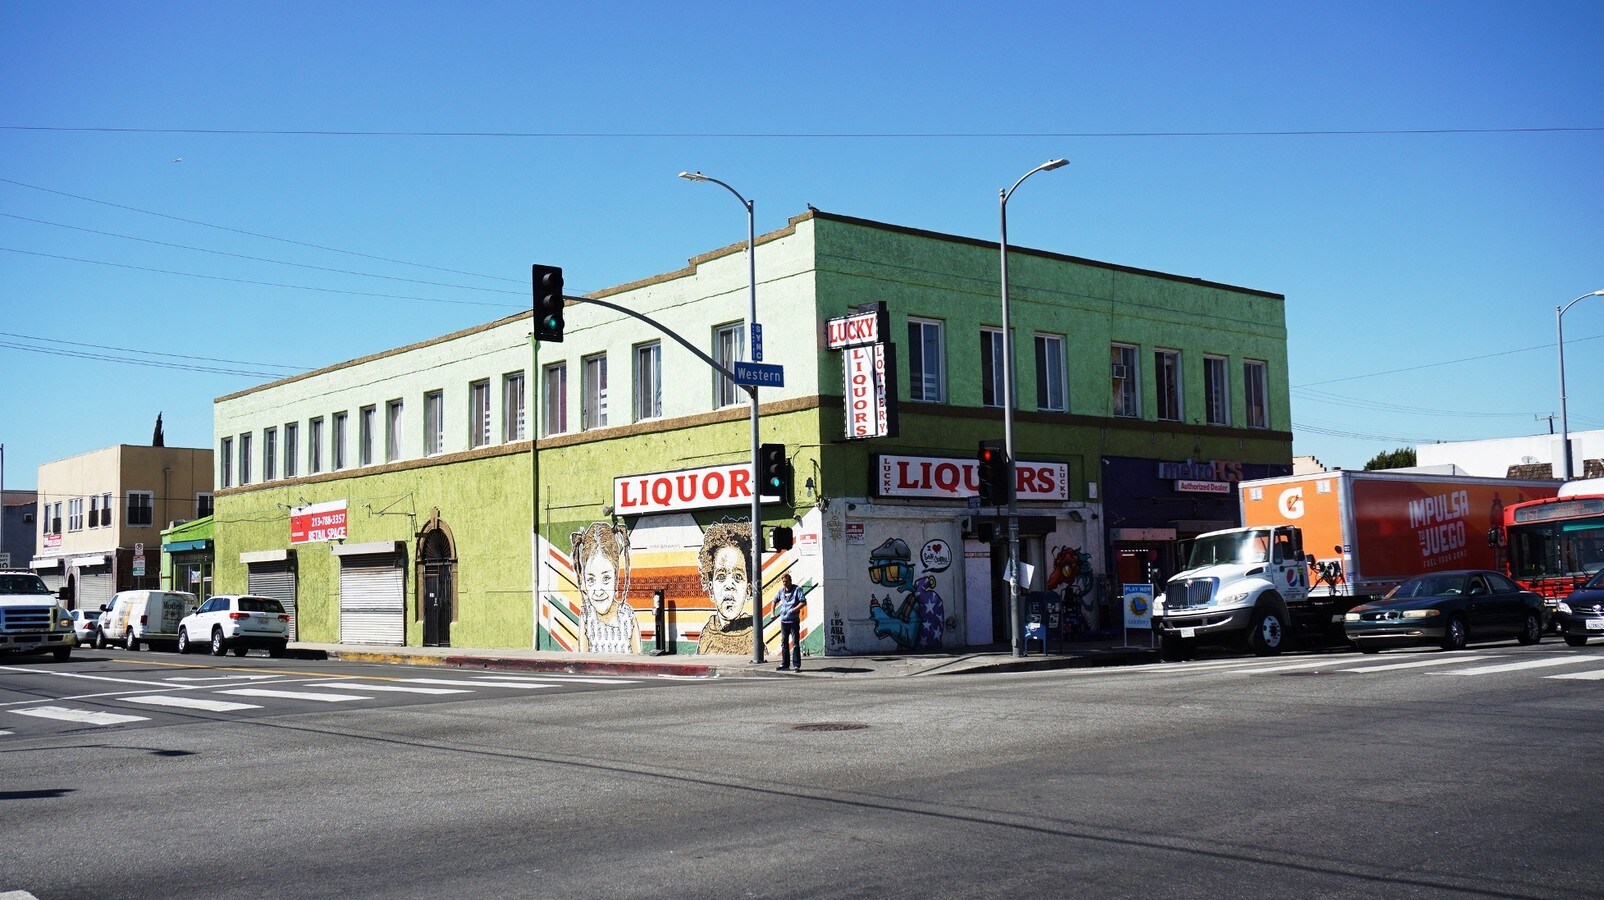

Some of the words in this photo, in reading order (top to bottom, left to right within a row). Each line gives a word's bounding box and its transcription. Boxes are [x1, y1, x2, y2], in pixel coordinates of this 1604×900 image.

[829, 317, 874, 343] LUCKY
[737, 367, 781, 382] Western
[852, 349, 867, 436] LIQUORS
[876, 347, 885, 433] LOTTERY
[621, 469, 751, 507] LIQUOR
[897, 461, 1055, 493] LIQURS
[1181, 482, 1210, 491] Authorized
[1210, 483, 1228, 492] Dealer
[1409, 490, 1469, 528] IMPULSA
[1422, 520, 1466, 556] JUEGO
